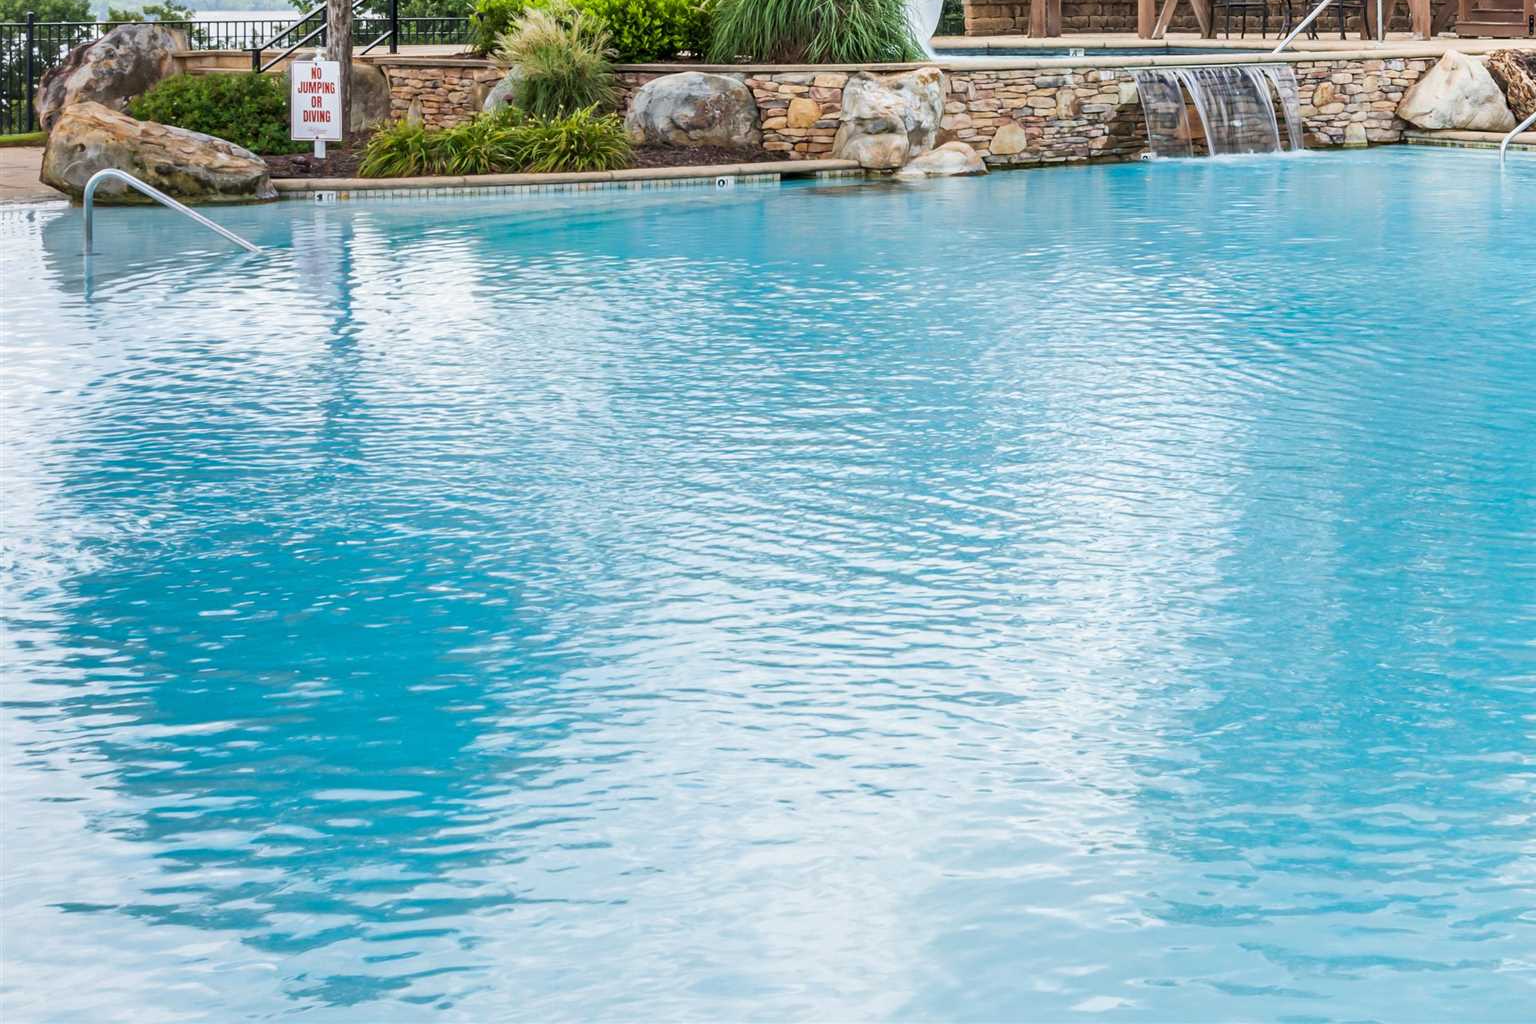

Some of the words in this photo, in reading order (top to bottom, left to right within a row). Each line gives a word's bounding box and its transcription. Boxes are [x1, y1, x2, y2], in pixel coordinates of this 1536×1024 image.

[311, 67, 322, 79] NO
[297, 81, 335, 94] JUMPING
[311, 96, 322, 108] OR
[303, 110, 331, 123] DIVING
